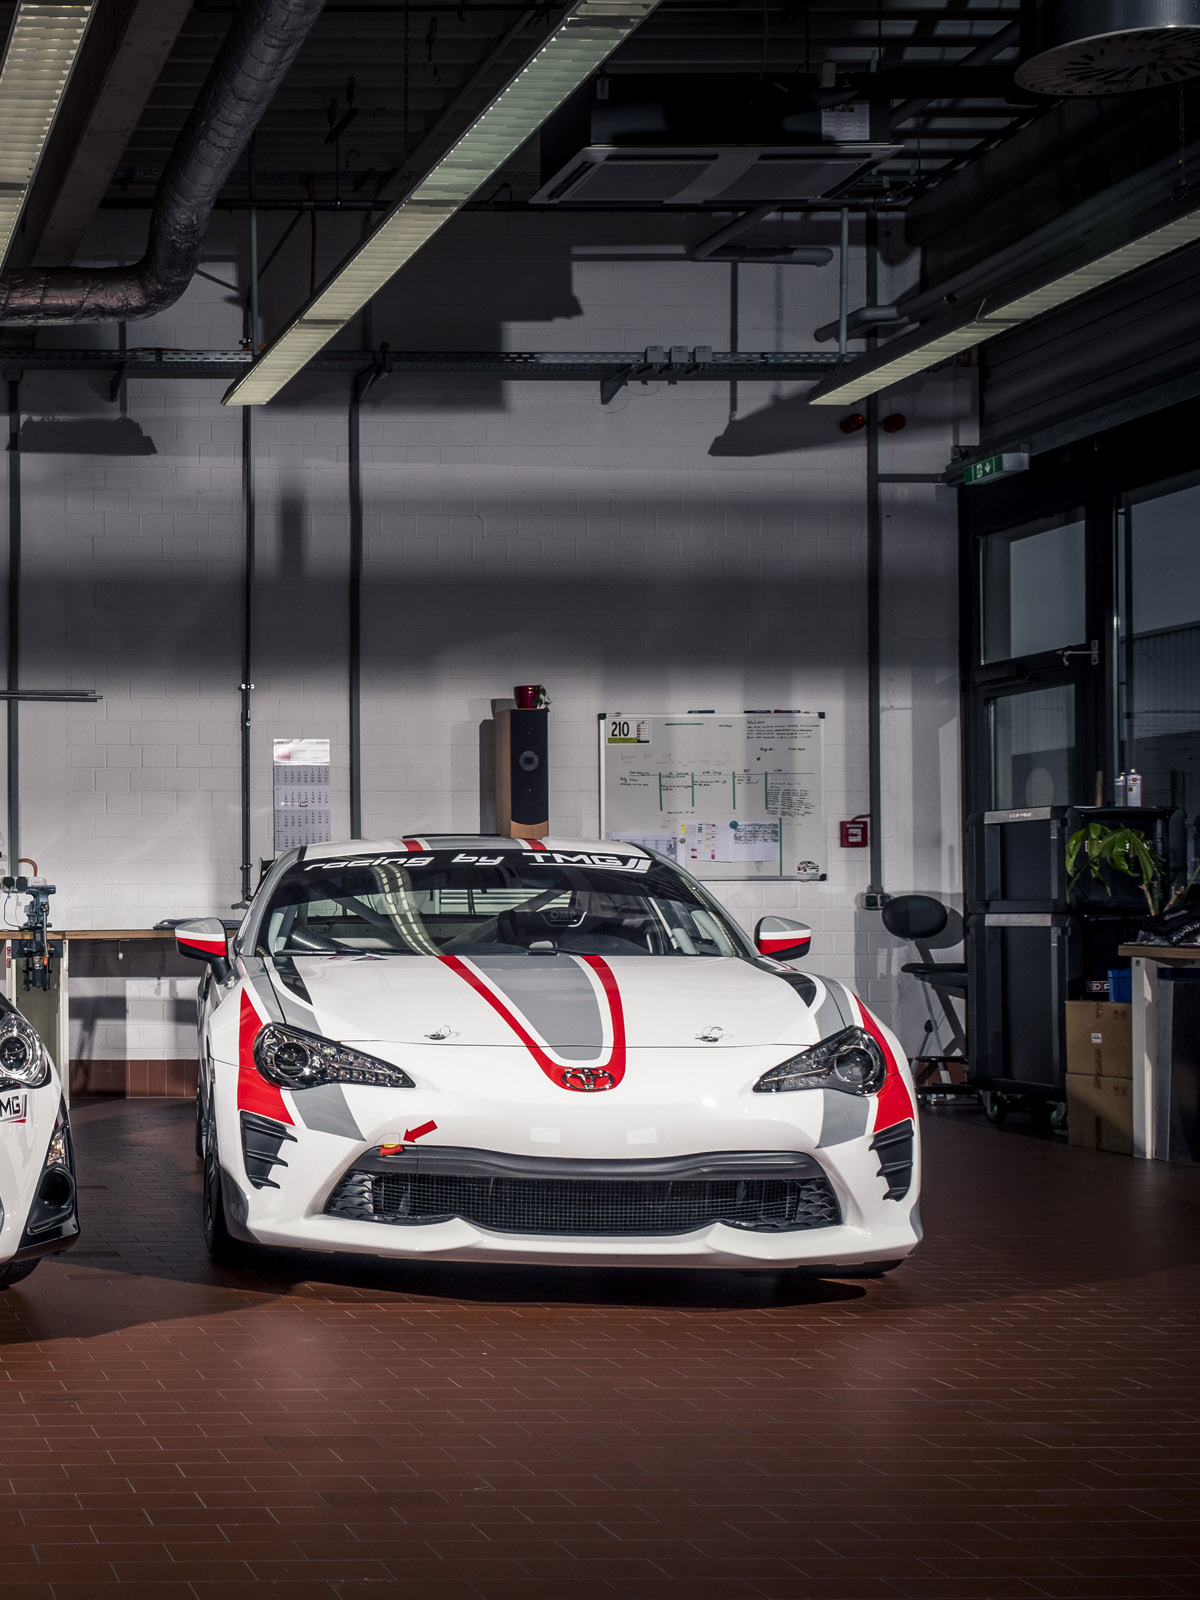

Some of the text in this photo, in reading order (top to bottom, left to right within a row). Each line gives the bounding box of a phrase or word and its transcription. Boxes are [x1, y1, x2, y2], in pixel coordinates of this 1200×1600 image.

[611, 721, 630, 738] 210
[303, 852, 624, 871] racing by TMG
[550, 911, 577, 919] OMP
